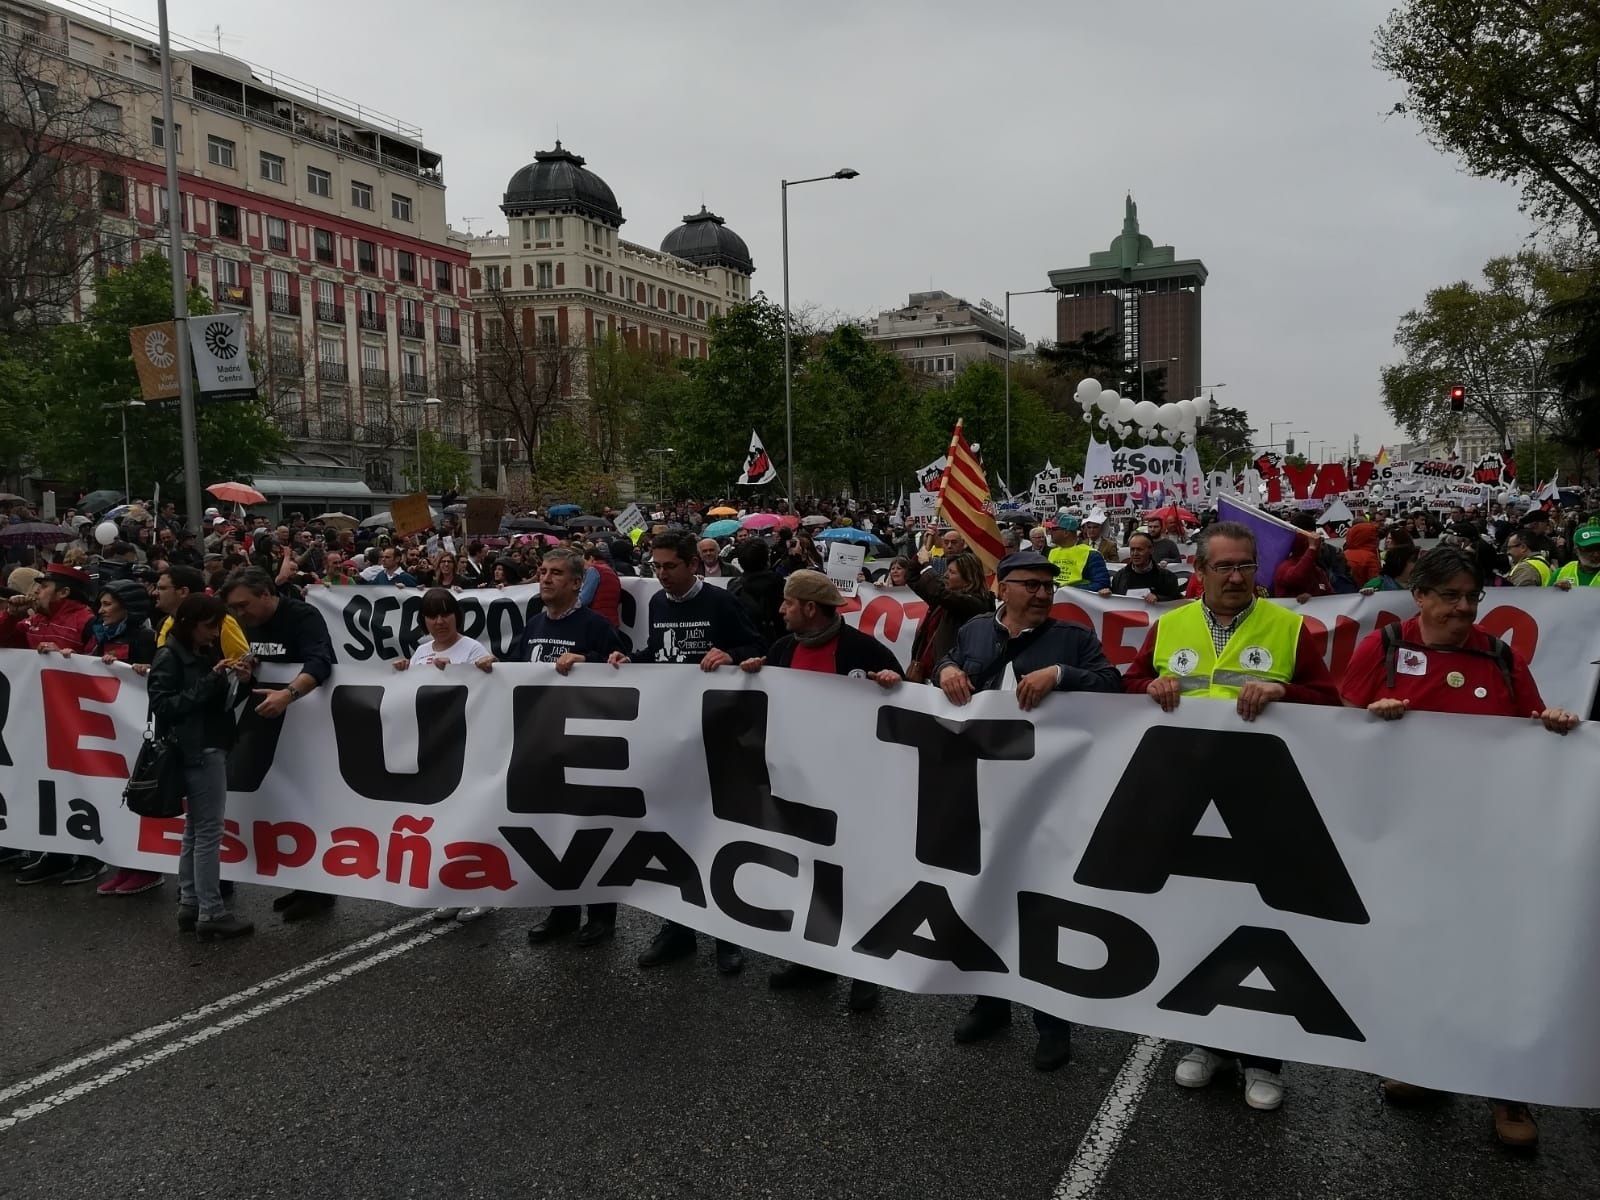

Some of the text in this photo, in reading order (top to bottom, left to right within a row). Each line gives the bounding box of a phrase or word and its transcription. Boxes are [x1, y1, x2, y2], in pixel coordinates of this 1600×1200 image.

[1112, 453, 1184, 475] #Sori
[1039, 483, 1057, 495] 8,6
[38, 779, 104, 845] la
